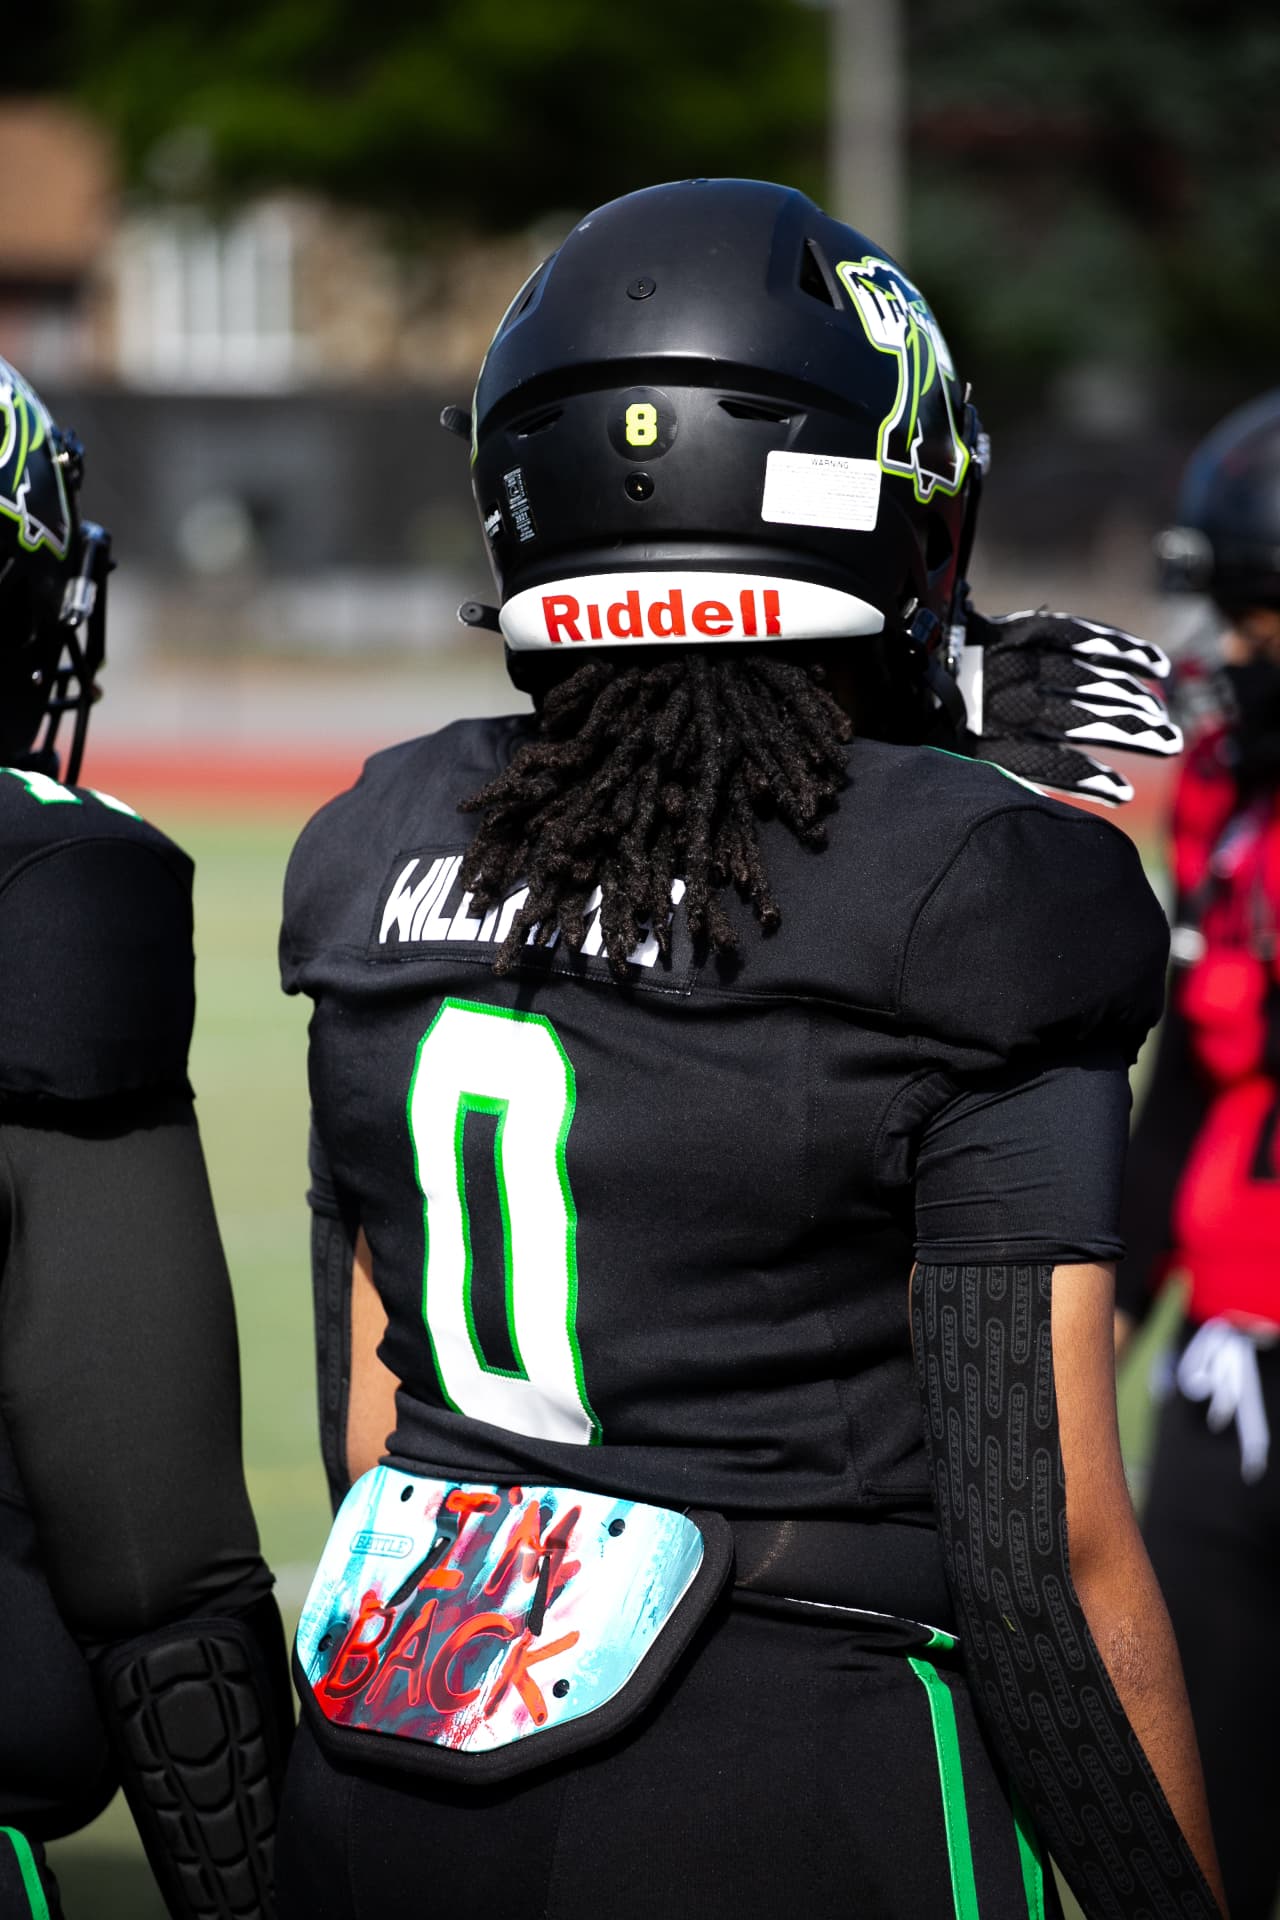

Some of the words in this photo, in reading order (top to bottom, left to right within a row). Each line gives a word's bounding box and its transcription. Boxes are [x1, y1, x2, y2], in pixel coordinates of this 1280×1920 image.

[625, 403, 658, 446] 8
[811, 459, 850, 470] WARNING
[542, 589, 781, 643] Riddell
[407, 996, 603, 1446] 0
[323, 1589, 581, 1727] BACK
